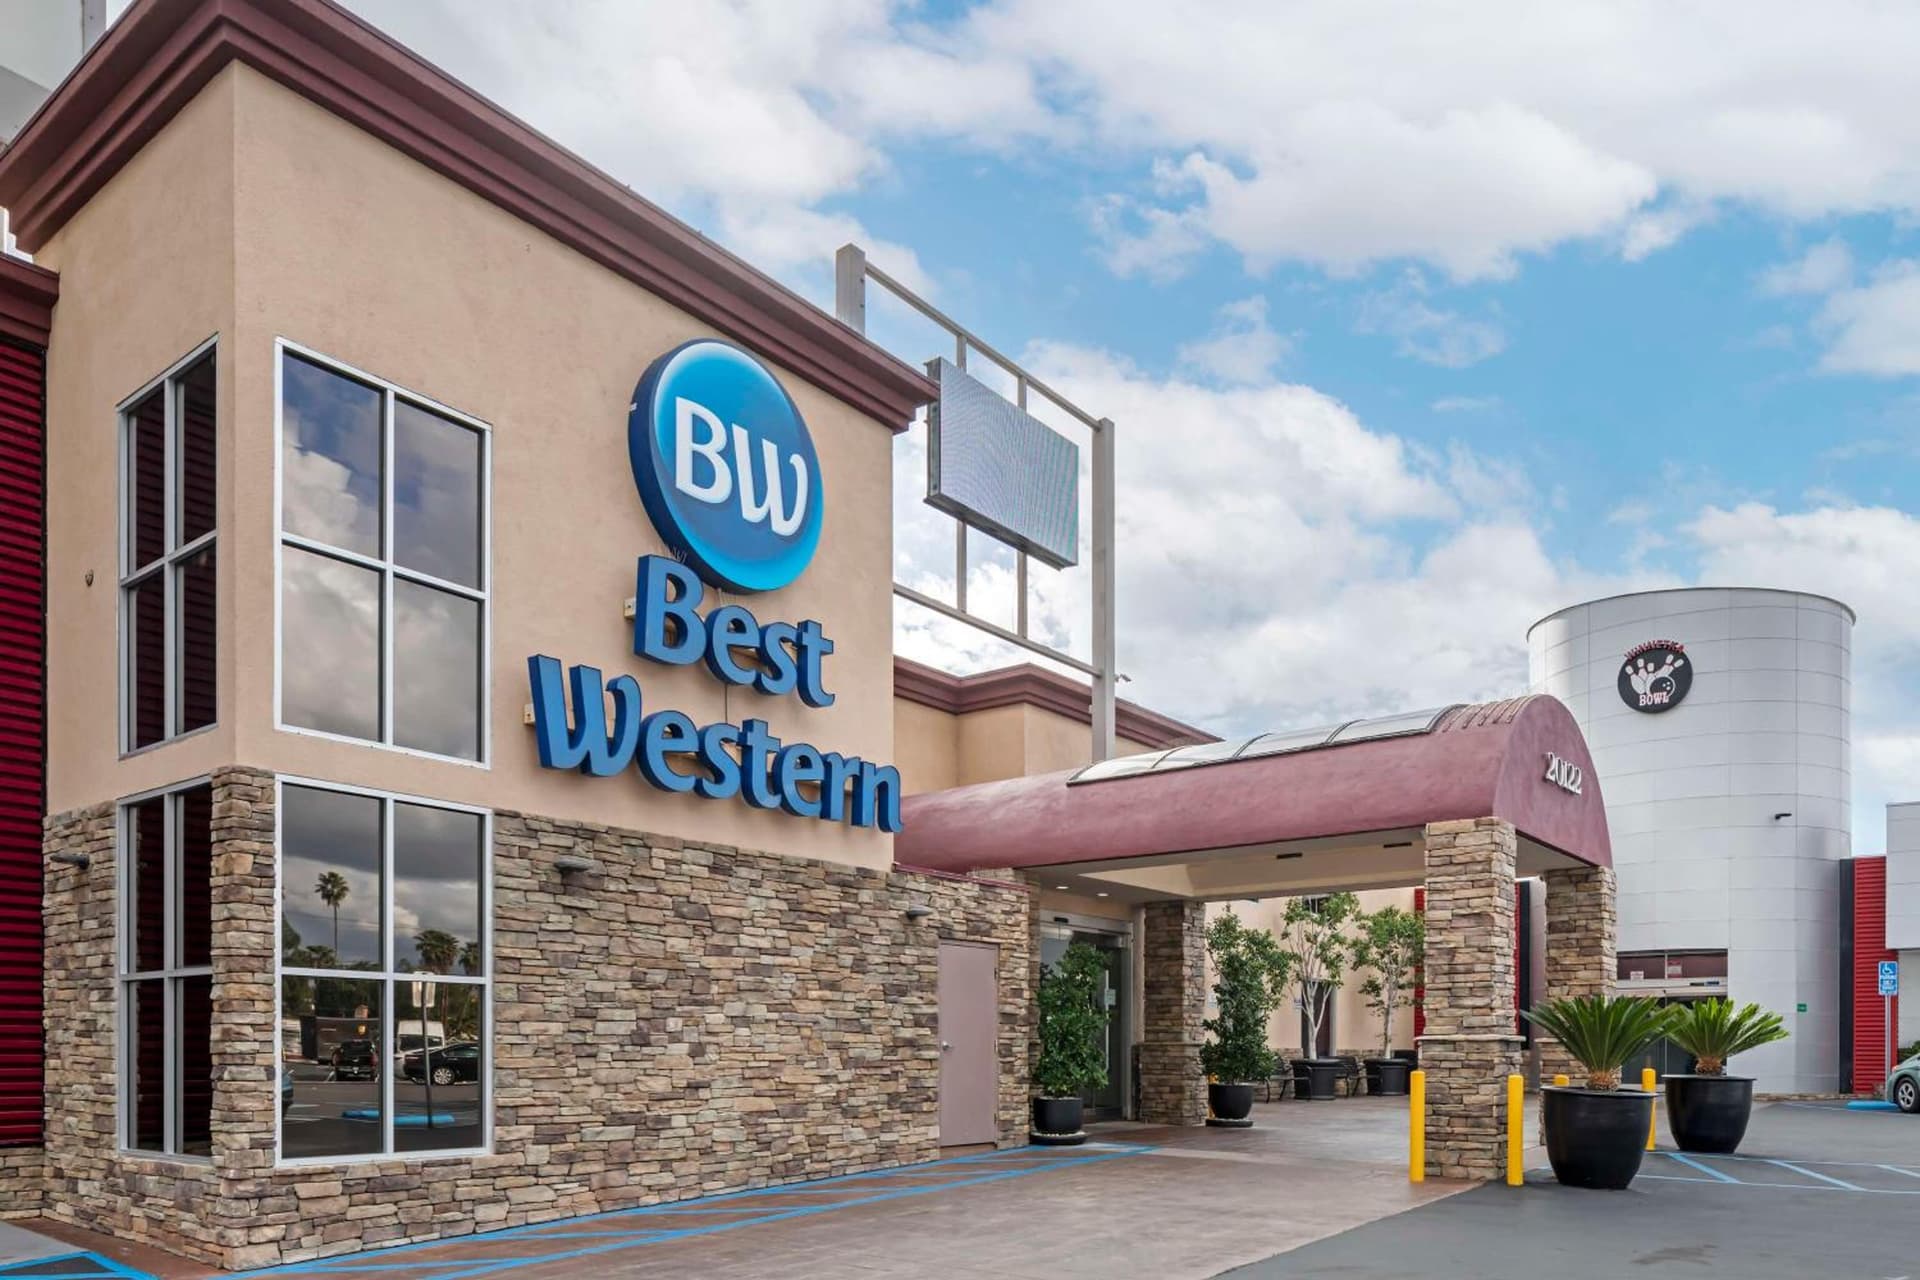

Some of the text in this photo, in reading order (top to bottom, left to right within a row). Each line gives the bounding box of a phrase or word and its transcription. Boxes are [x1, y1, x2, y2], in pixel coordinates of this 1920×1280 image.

[676, 397, 808, 536] BW
[634, 554, 835, 708] Best
[1639, 691, 1669, 706] BOWL
[528, 654, 904, 833] Western
[1545, 751, 1582, 794] 20122
